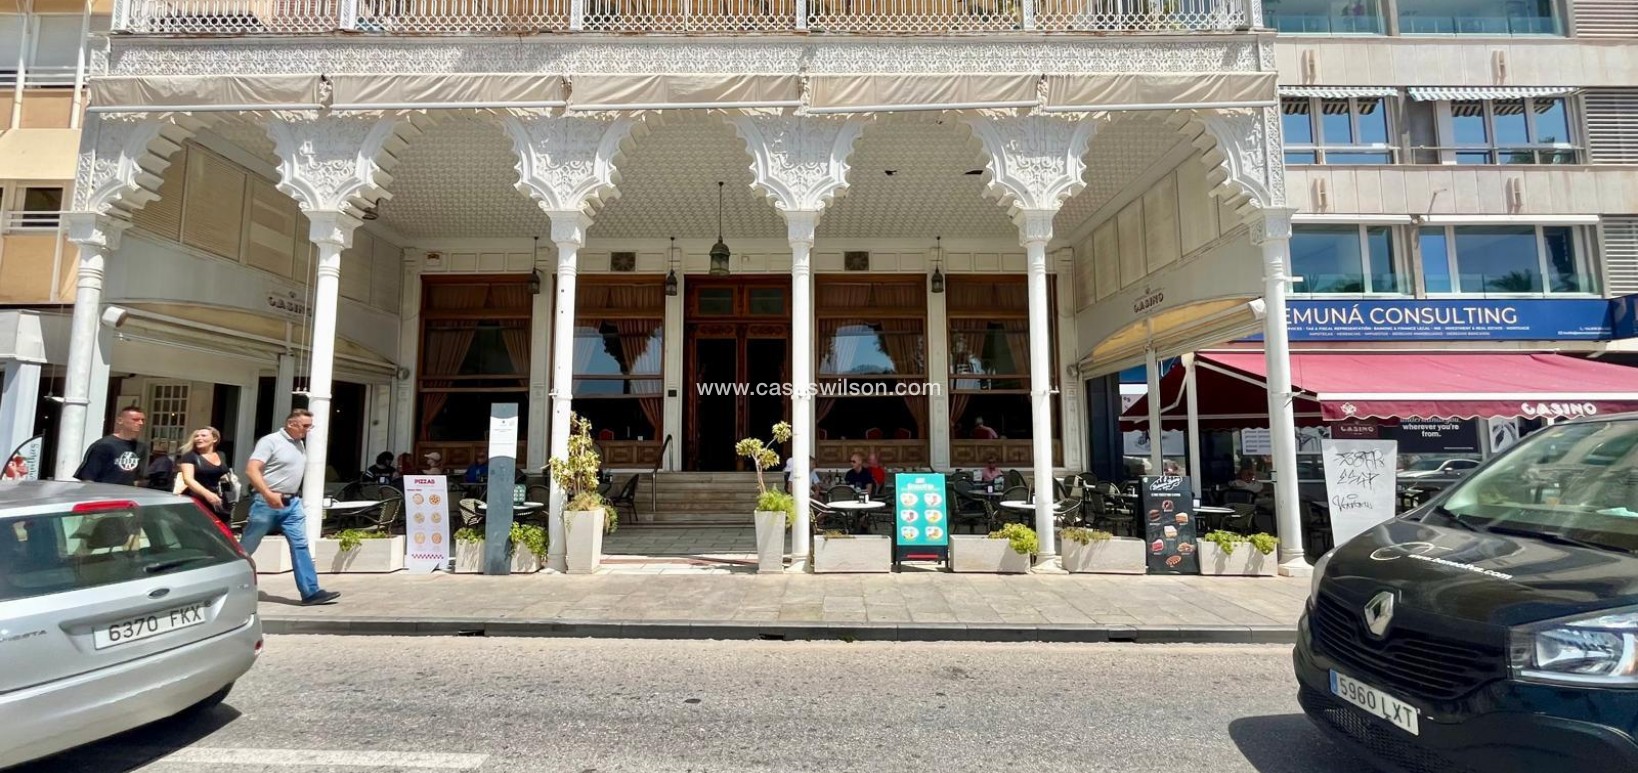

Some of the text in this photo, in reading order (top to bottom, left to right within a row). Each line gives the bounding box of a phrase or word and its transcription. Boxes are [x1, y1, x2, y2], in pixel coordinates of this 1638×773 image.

[1370, 307, 1517, 324] CONSULTING
[1521, 402, 1597, 415] CASINO
[1438, 423, 1460, 431] you're
[108, 605, 202, 641] 6370 FKX
[1340, 678, 1412, 727] 5960 LXT
